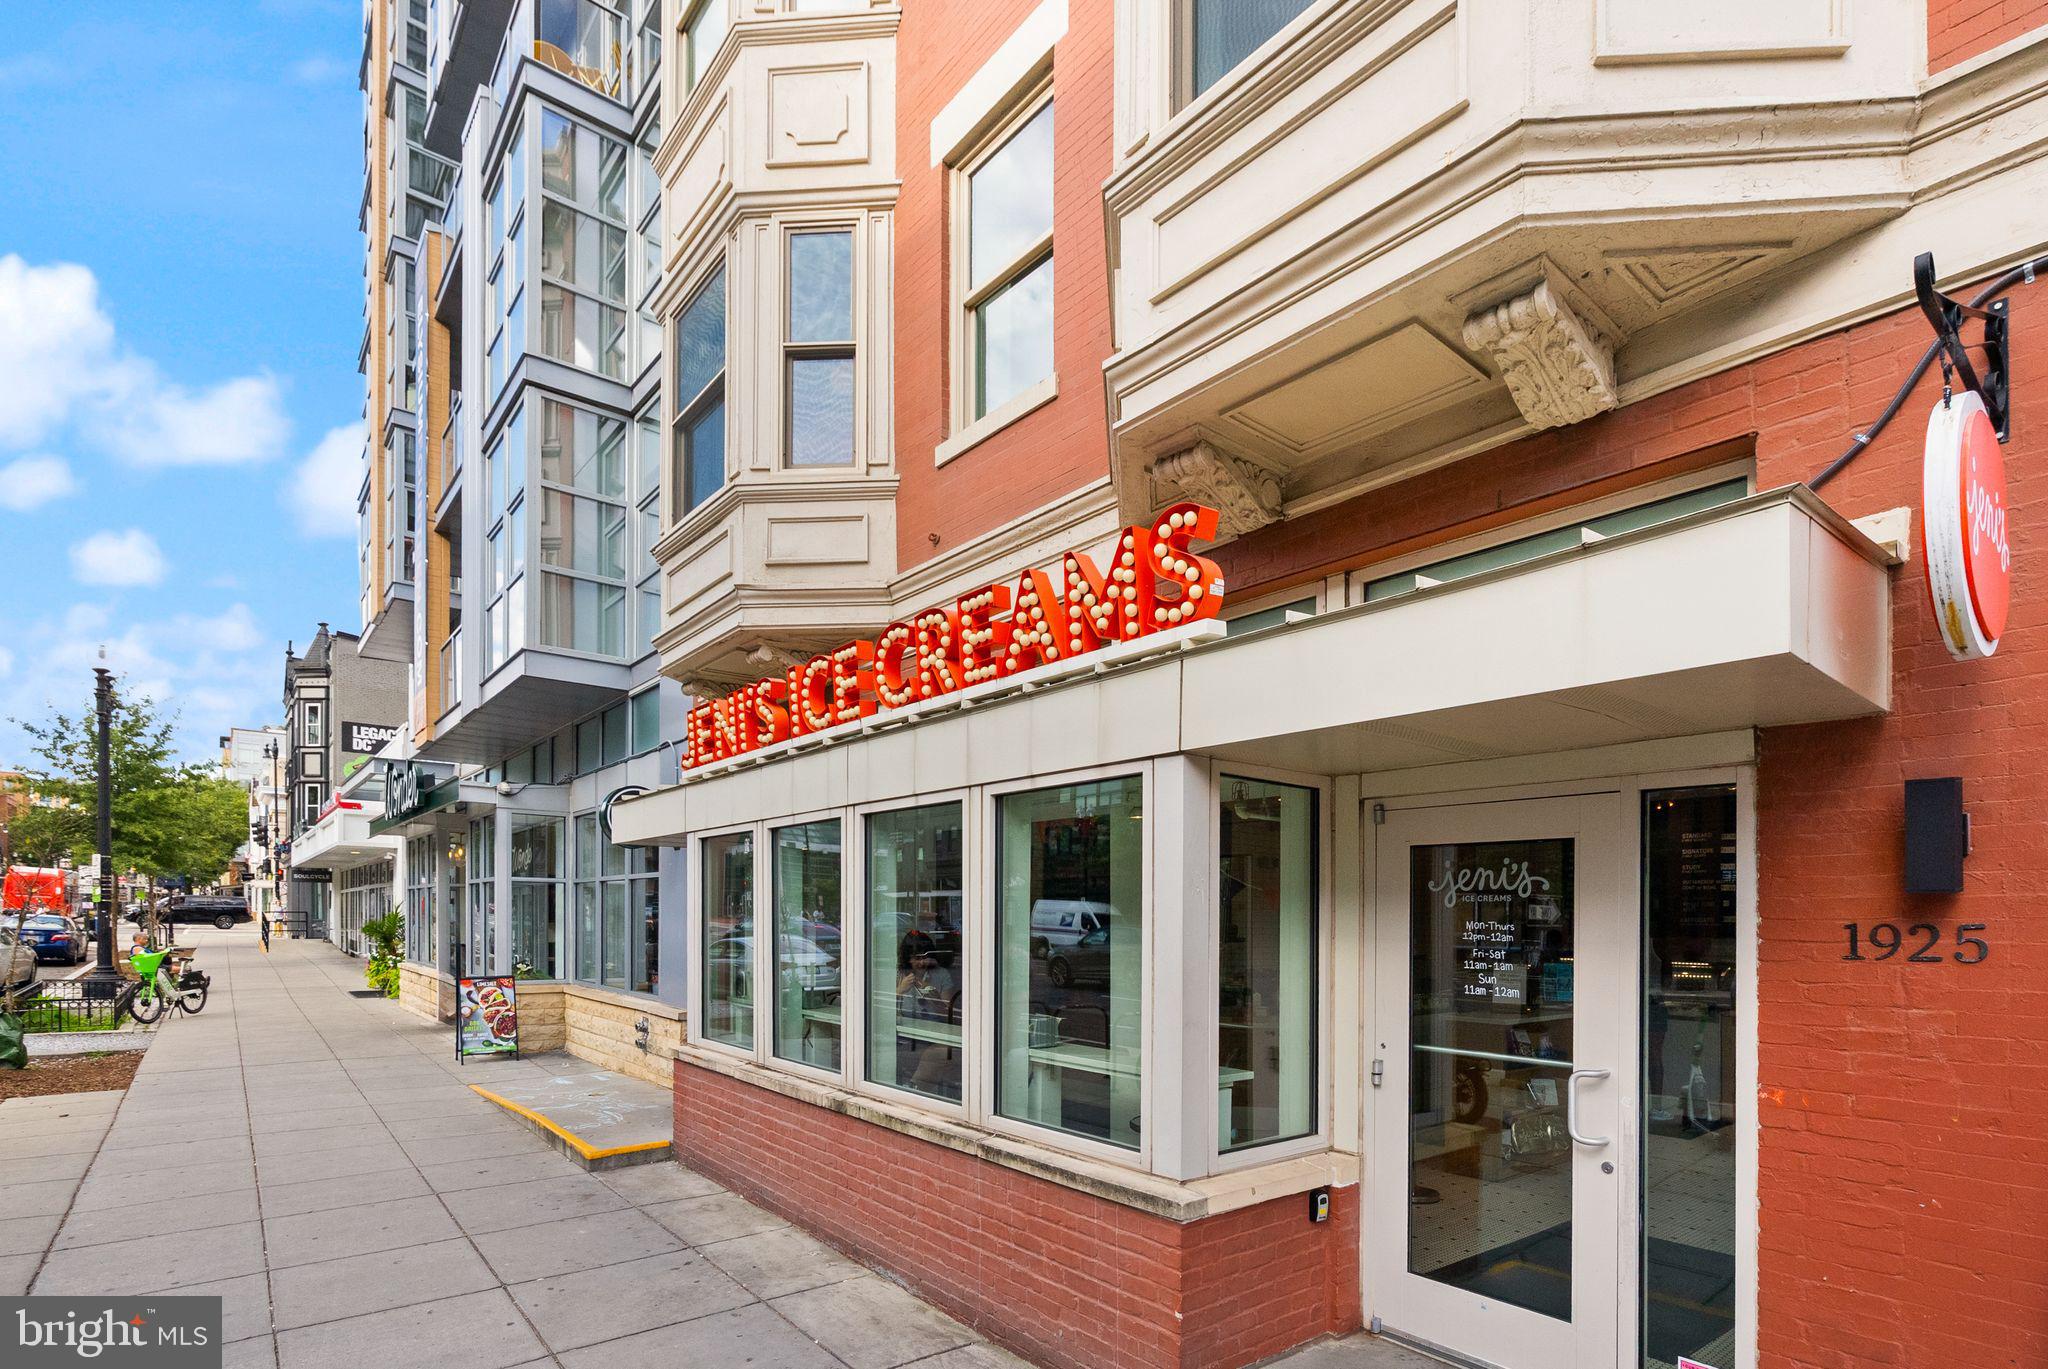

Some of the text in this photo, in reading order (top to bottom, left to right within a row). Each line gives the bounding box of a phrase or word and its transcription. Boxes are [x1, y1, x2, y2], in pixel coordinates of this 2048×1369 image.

[1967, 457, 2010, 573] jeni's
[787, 639, 876, 737] ICE
[874, 502, 1224, 709] CREAMS
[352, 725, 397, 741] LEGAC
[1428, 857, 1550, 908] jeni's
[1462, 894, 1512, 902] ICE CREAMS
[1465, 920, 1515, 931] Mon-Thurs
[1841, 923, 1989, 964] 1925
[1472, 948, 1507, 960] Fri-Sat
[1478, 972, 1498, 984] Sun
